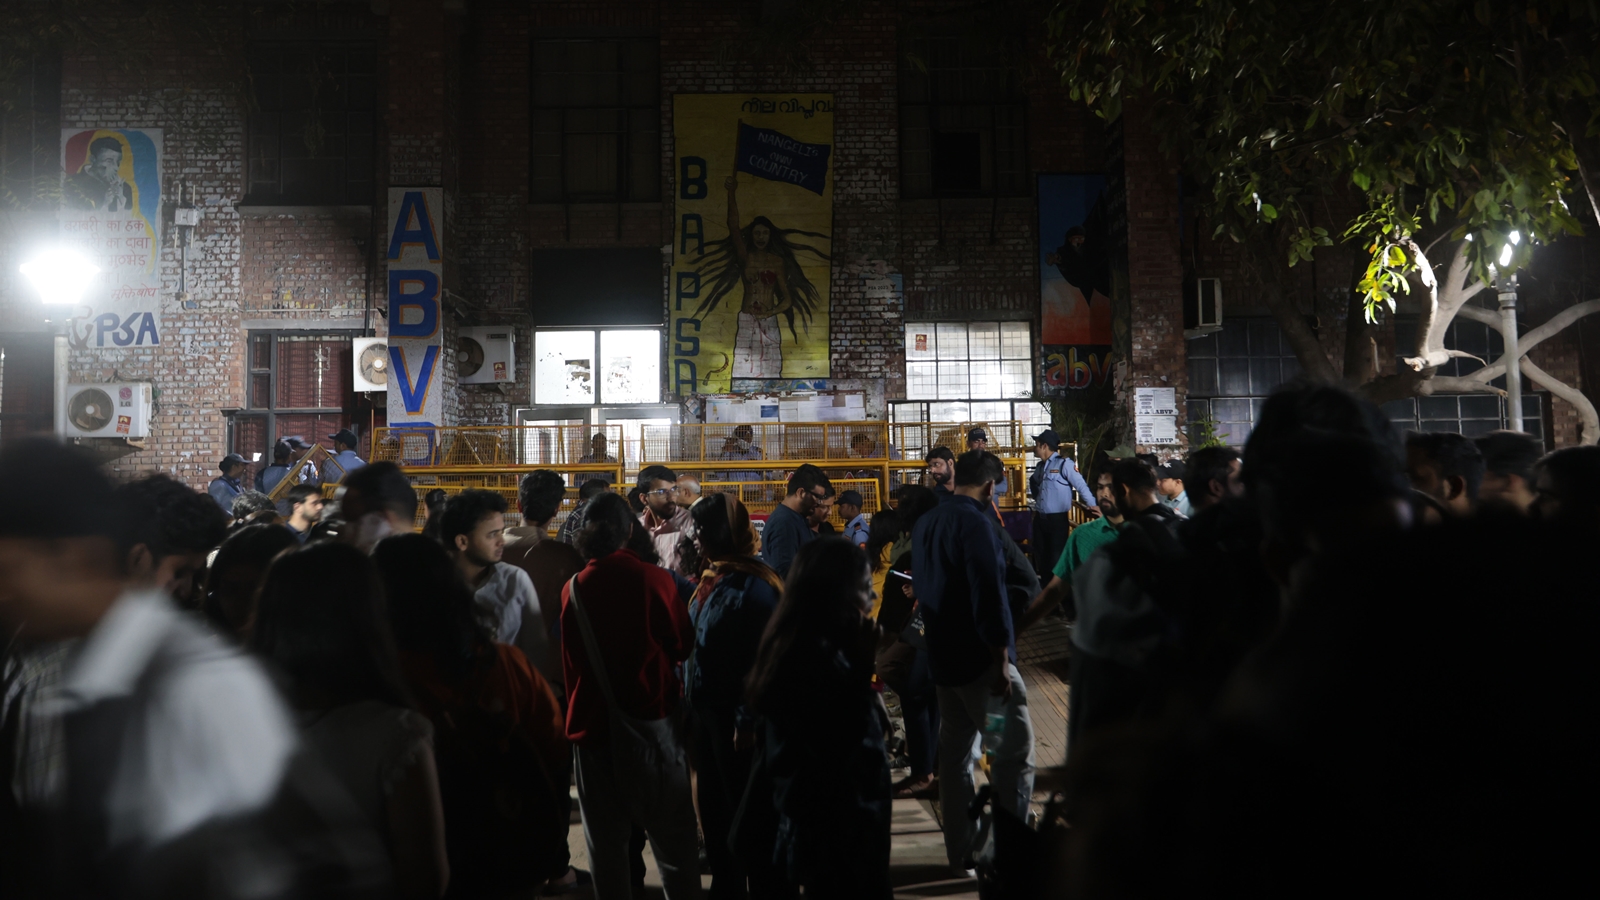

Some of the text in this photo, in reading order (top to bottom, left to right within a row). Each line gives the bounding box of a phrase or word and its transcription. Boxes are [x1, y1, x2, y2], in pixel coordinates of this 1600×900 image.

[769, 151, 793, 166] OWN
[748, 154, 808, 184] COUNTRY
[106, 220, 121, 232] का
[106, 238, 121, 249] का
[125, 237, 151, 249] दावा
[674, 156, 707, 396] BAPSA
